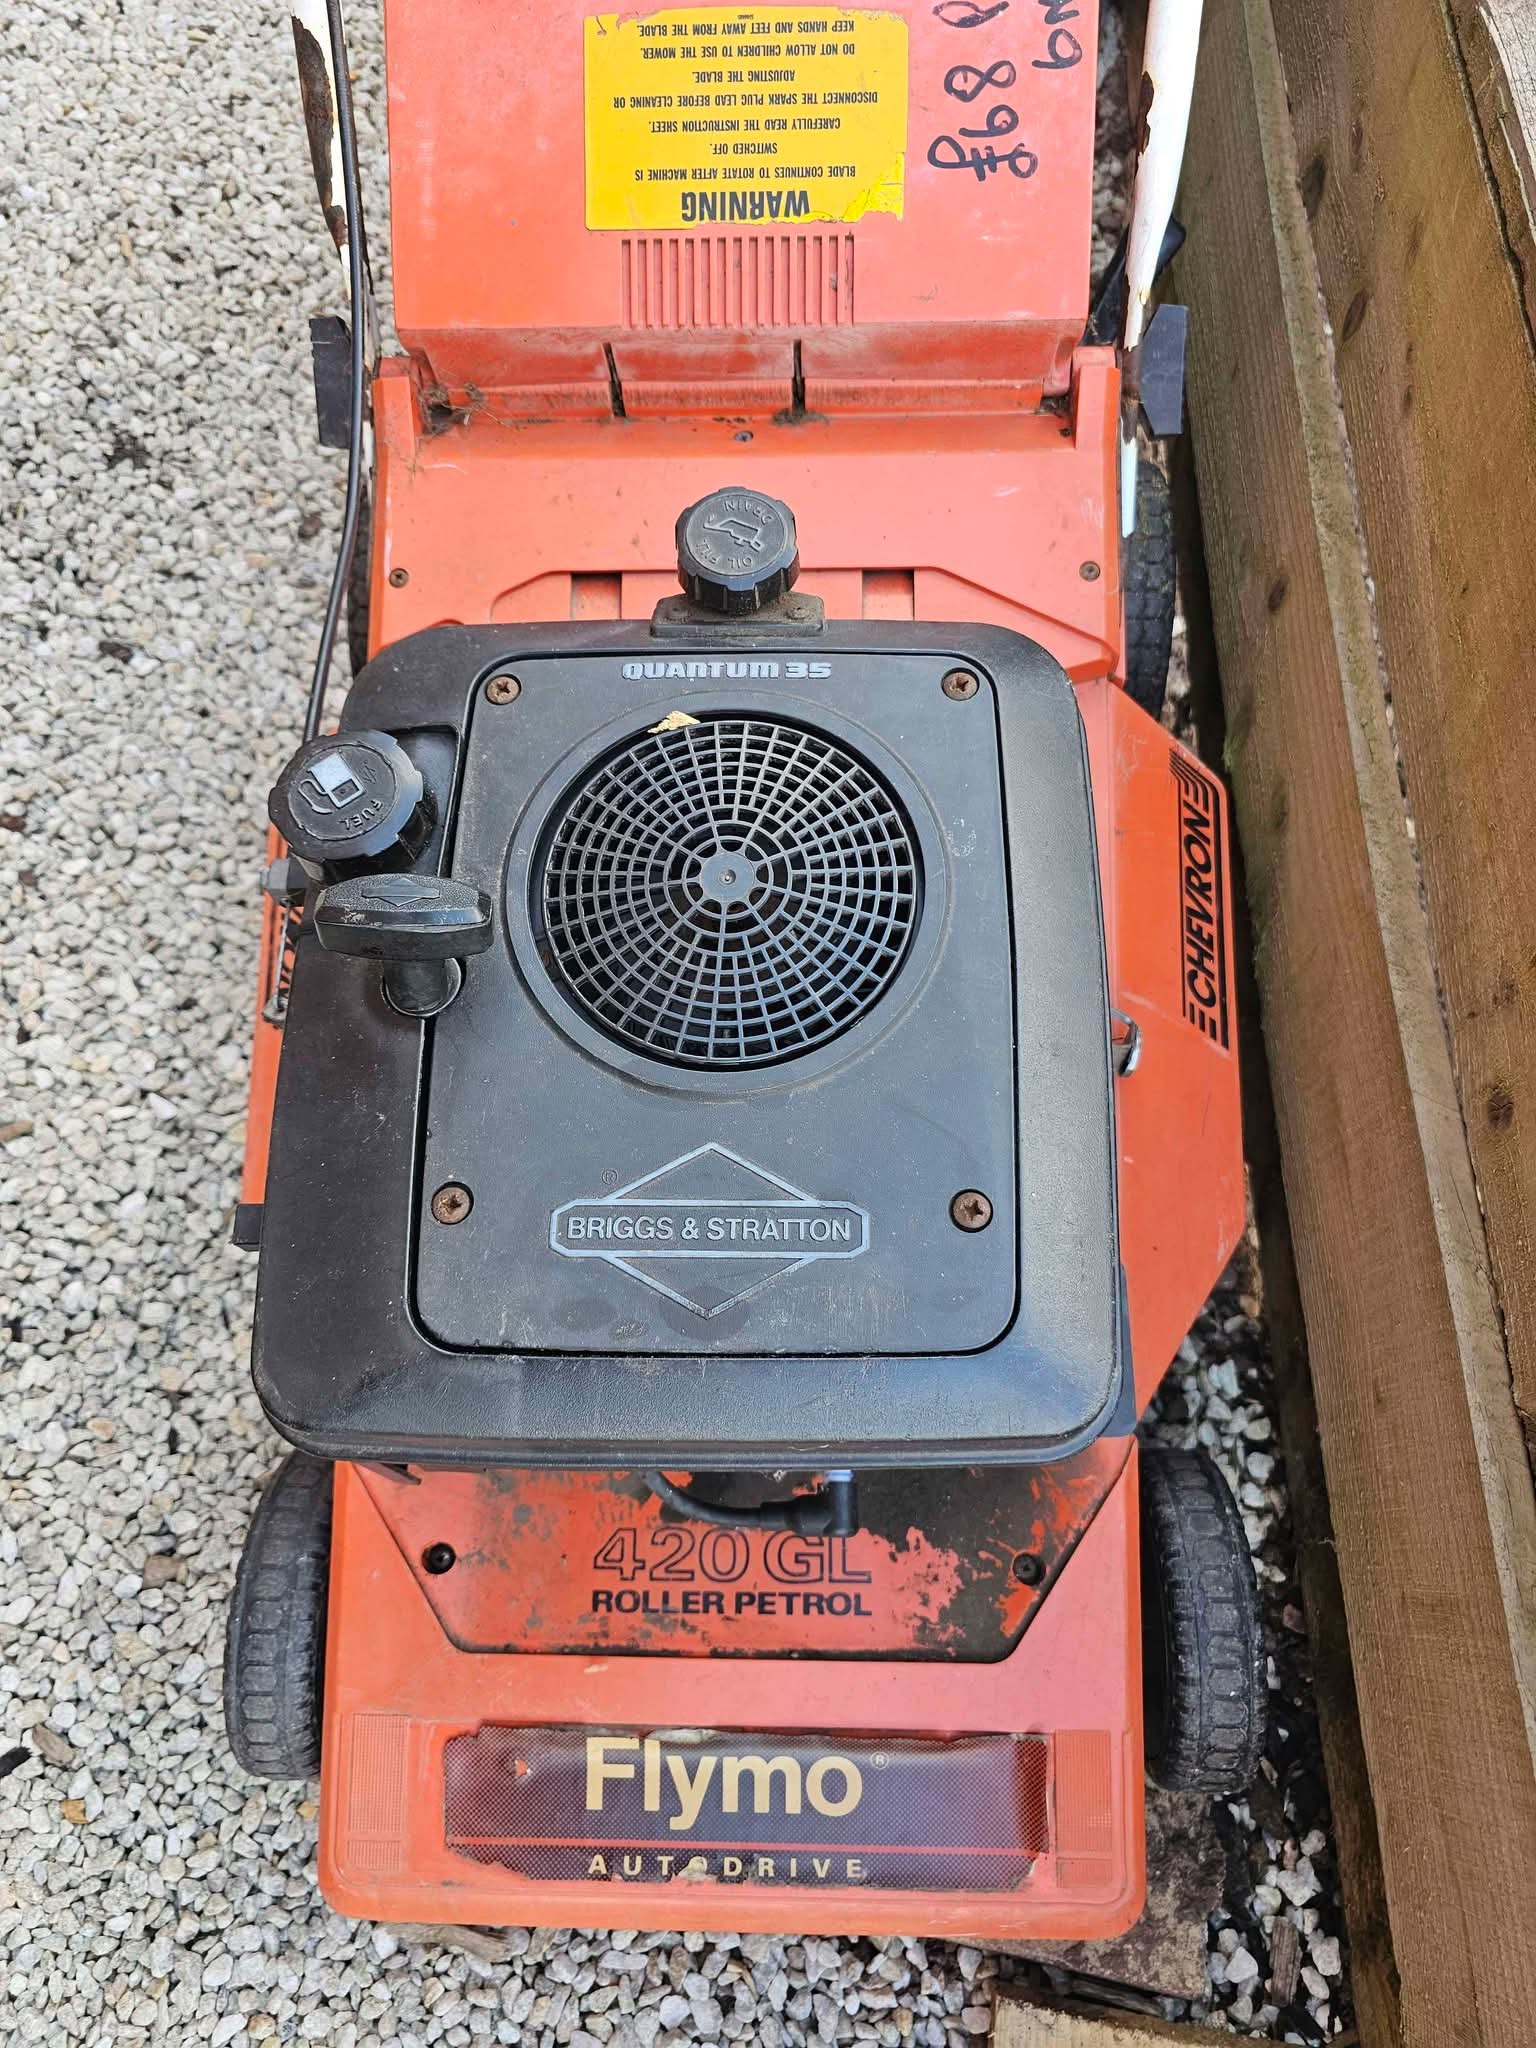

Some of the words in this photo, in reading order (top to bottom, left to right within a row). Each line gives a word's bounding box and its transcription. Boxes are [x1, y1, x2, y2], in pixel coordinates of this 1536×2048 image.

[637, 24, 668, 37] BLADE.
[672, 24, 688, 35] THE
[692, 23, 718, 35] FROM
[721, 22, 746, 34] AWAY
[750, 22, 771, 34] FEET
[775, 21, 794, 34] AND
[797, 20, 828, 33] HANDS
[831, 20, 855, 32] KEEP
[640, 46, 677, 59] MOWER.
[681, 46, 697, 58] THE
[701, 46, 718, 58] USE
[722, 45, 733, 57] TO
[737, 44, 781, 57] CHILDREN
[785, 44, 817, 56] ALLOW
[821, 43, 838, 55] NOT
[842, 43, 855, 55] DO
[692, 71, 723, 83] BLADE.
[727, 71, 744, 82] THE
[748, 69, 796, 82] ADJUSTING
[613, 96, 626, 108] OR
[630, 95, 673, 108] CLEANING
[677, 95, 711, 107] BEFORE
[714, 94, 737, 106] LEAD
[741, 93, 764, 105] PLUG
[768, 93, 797, 105] SPARK
[801, 93, 818, 105] THE
[822, 91, 878, 104] DISCONNECT
[648, 121, 678, 133] SHEET.
[682, 119, 740, 132] INSTRUCTION
[744, 119, 760, 131] THE
[764, 119, 788, 130] READ
[792, 118, 841, 130] CAREFULLY
[709, 143, 729, 155] OFF.
[732, 142, 778, 154] SWITCHED
[634, 169, 644, 181] IS
[647, 168, 688, 181] MACHINE
[691, 168, 718, 180] AFTER
[722, 167, 755, 179] ROTATE
[758, 167, 770, 179] TO
[774, 166, 823, 179] CONTINUES
[827, 165, 856, 178] BLADE
[681, 190, 810, 222] WARNING
[728, 557, 753, 569] OIL
[621, 661, 779, 681] QUANTUM
[784, 662, 832, 679] 35
[340, 799, 383, 829] FUEL
[1182, 799, 1217, 1009] CHEVRON
[567, 1215, 673, 1240] BRIGGS
[681, 1217, 700, 1240] &
[706, 1217, 851, 1242] STRATTON
[593, 1526, 750, 1583] 420
[763, 1530, 872, 1584] GL
[591, 1589, 725, 1614] ROLLER
[734, 1591, 872, 1616] PETROL
[585, 1736, 863, 1831] Flymo
